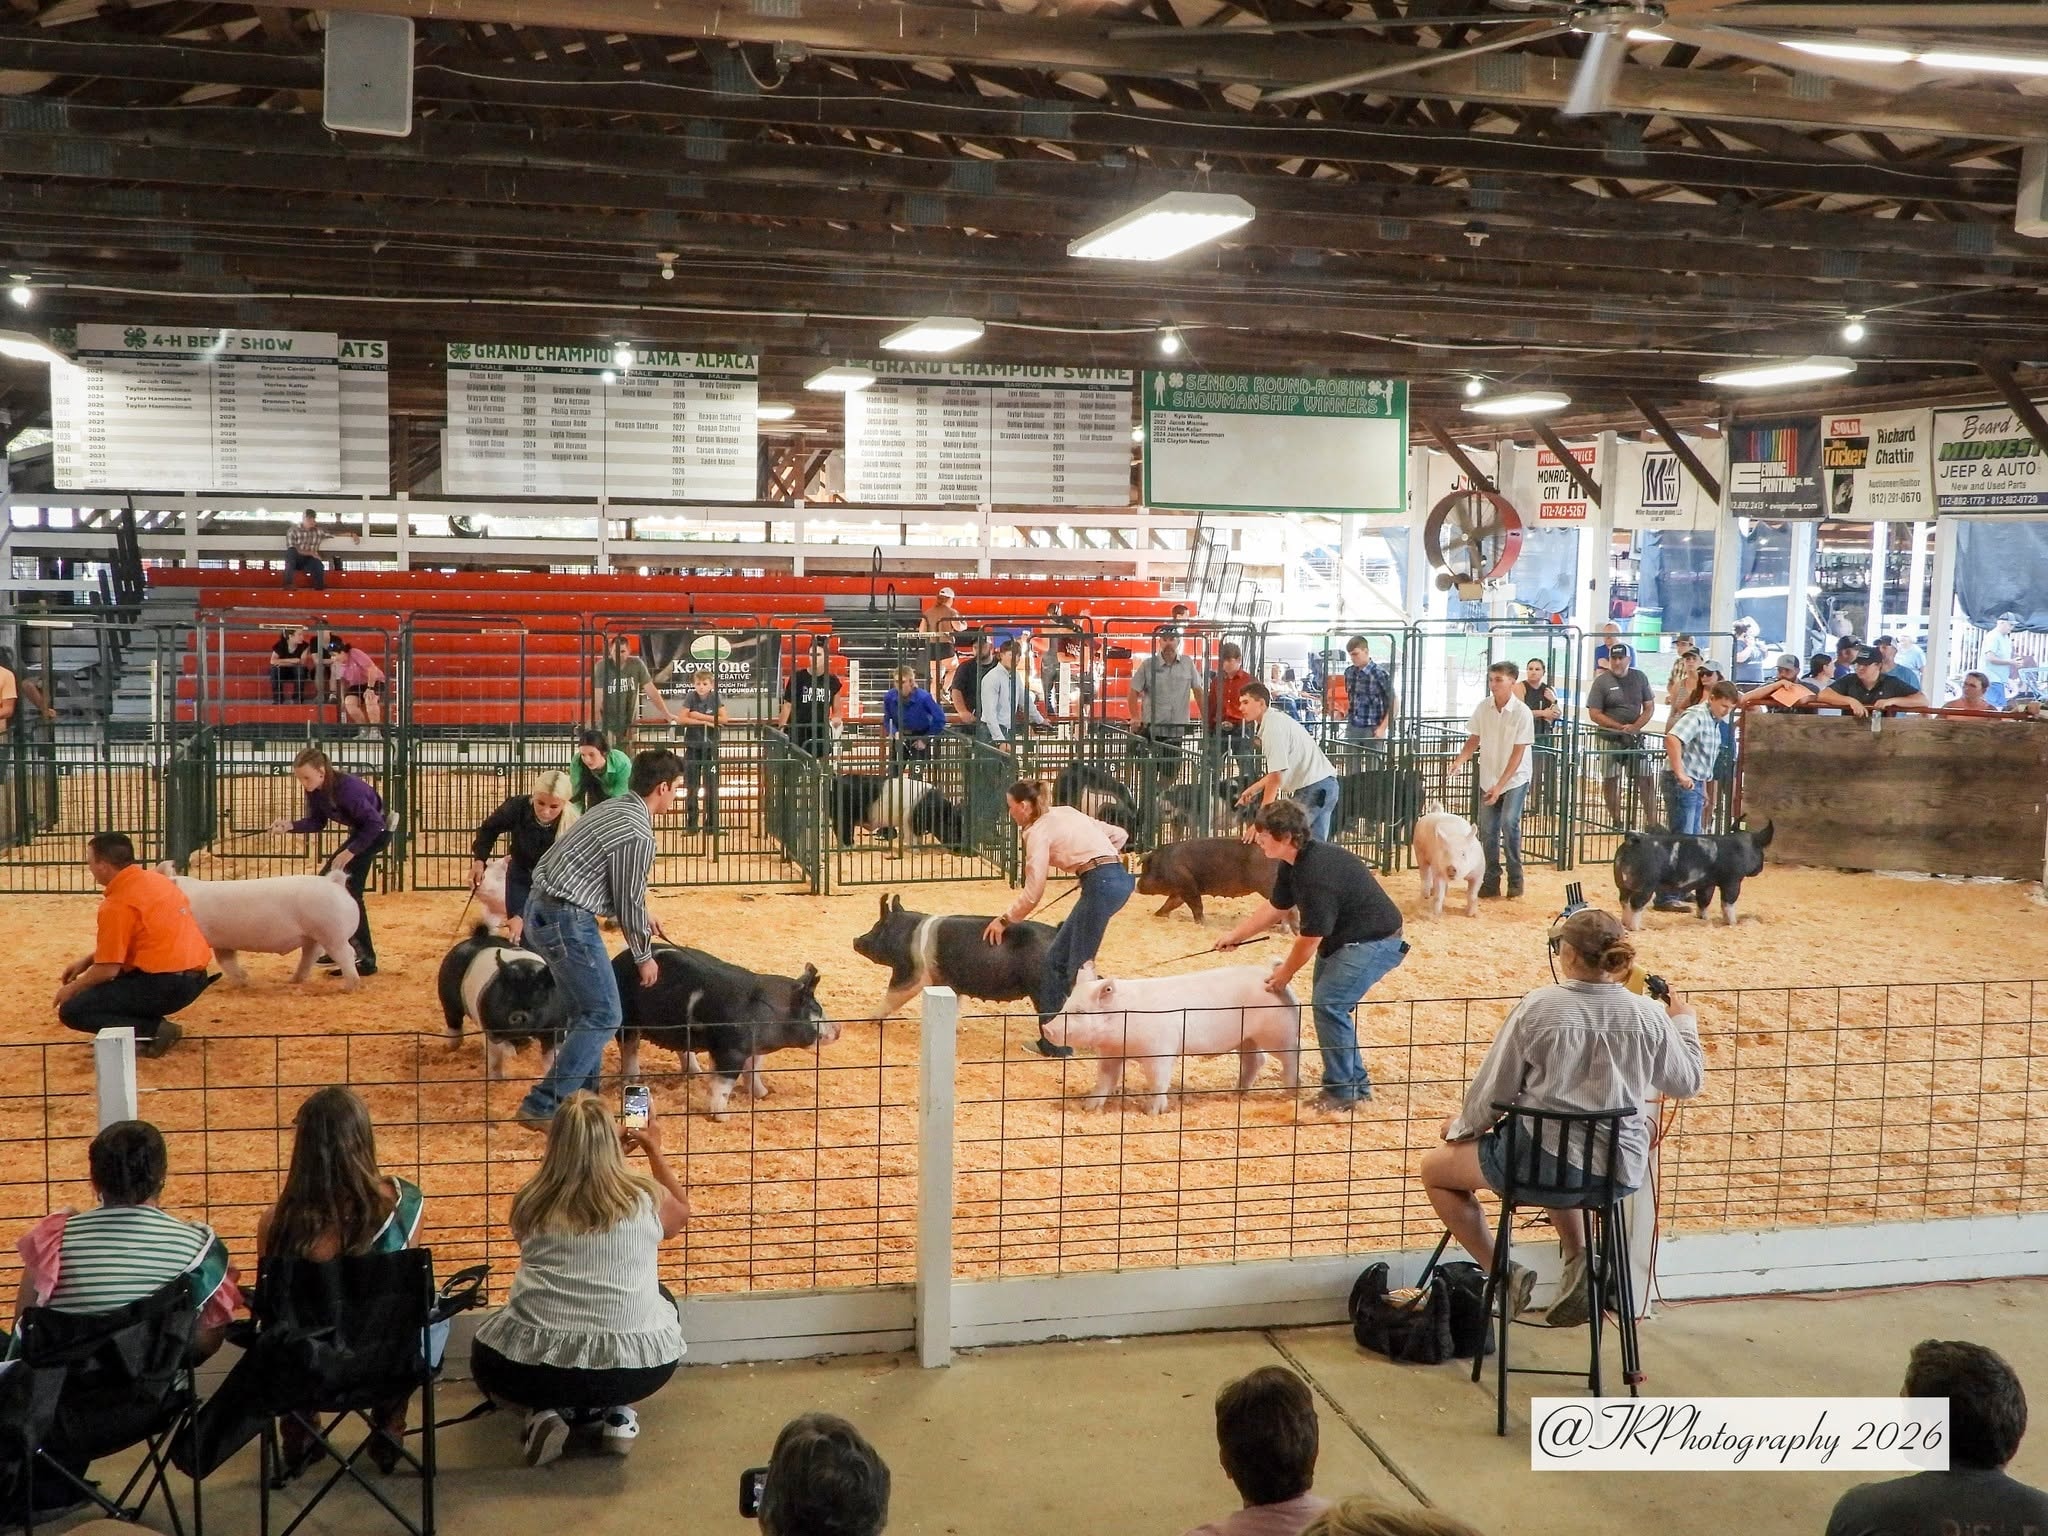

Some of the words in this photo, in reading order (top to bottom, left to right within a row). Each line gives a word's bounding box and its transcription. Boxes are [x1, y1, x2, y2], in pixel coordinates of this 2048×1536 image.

[152, 334, 181, 347] 4-H
[241, 337, 293, 351] SHOW
[341, 341, 384, 358] ATS
[474, 344, 529, 360] GRAND
[535, 346, 615, 363] CHAMPIO
[634, 351, 681, 366] LAMA
[696, 352, 755, 369] ALPACA
[871, 359, 942, 374] GRAND
[948, 361, 1057, 378] CHAMPION
[1063, 366, 1130, 380] SWINE
[1186, 373, 1249, 392] SENIOR
[1253, 376, 1367, 397] ROUND-ROBIN
[554, 398, 568, 406] Mary
[672, 402, 686, 410] 2020
[1172, 391, 1299, 412] SHOWMANSHIP
[1303, 396, 1378, 415] WINNERS
[468, 405, 482, 413] Mary
[673, 413, 685, 421] 2021
[614, 421, 635, 429] Reagan
[636, 422, 659, 430] Stafford
[672, 424, 686, 432] 2022
[697, 424, 718, 432] Reagan
[1833, 421, 1859, 435] SOLD
[672, 435, 686, 443] 2023
[1877, 426, 1916, 444] Richard
[523, 441, 536, 449] 2024
[718, 458, 736, 466] Mason
[1824, 446, 1867, 467] Tucker
[1875, 448, 1914, 465] Chattin
[1761, 461, 1787, 477] EWING
[1940, 464, 1977, 479] JEEP
[1981, 463, 1993, 477] &
[1996, 461, 2036, 477] AUTO
[1537, 469, 1569, 484] MONROE
[1760, 477, 1796, 493] PRINTING
[1951, 482, 1968, 491] New
[1969, 481, 1985, 491] and
[1987, 481, 2006, 490] Used
[2007, 480, 2027, 489] Parts
[1543, 486, 1560, 500] CITY
[1869, 493, 1887, 505] (812)
[1541, 505, 1585, 517] 812-743-5267
[1647, 753, 1653, 762] 9
[60, 765, 66, 775] 1
[273, 766, 280, 775] 2
[497, 767, 504, 776] 3
[710, 765, 717, 774] 4
[914, 764, 921, 774] 5
[1109, 762, 1116, 772] 6
